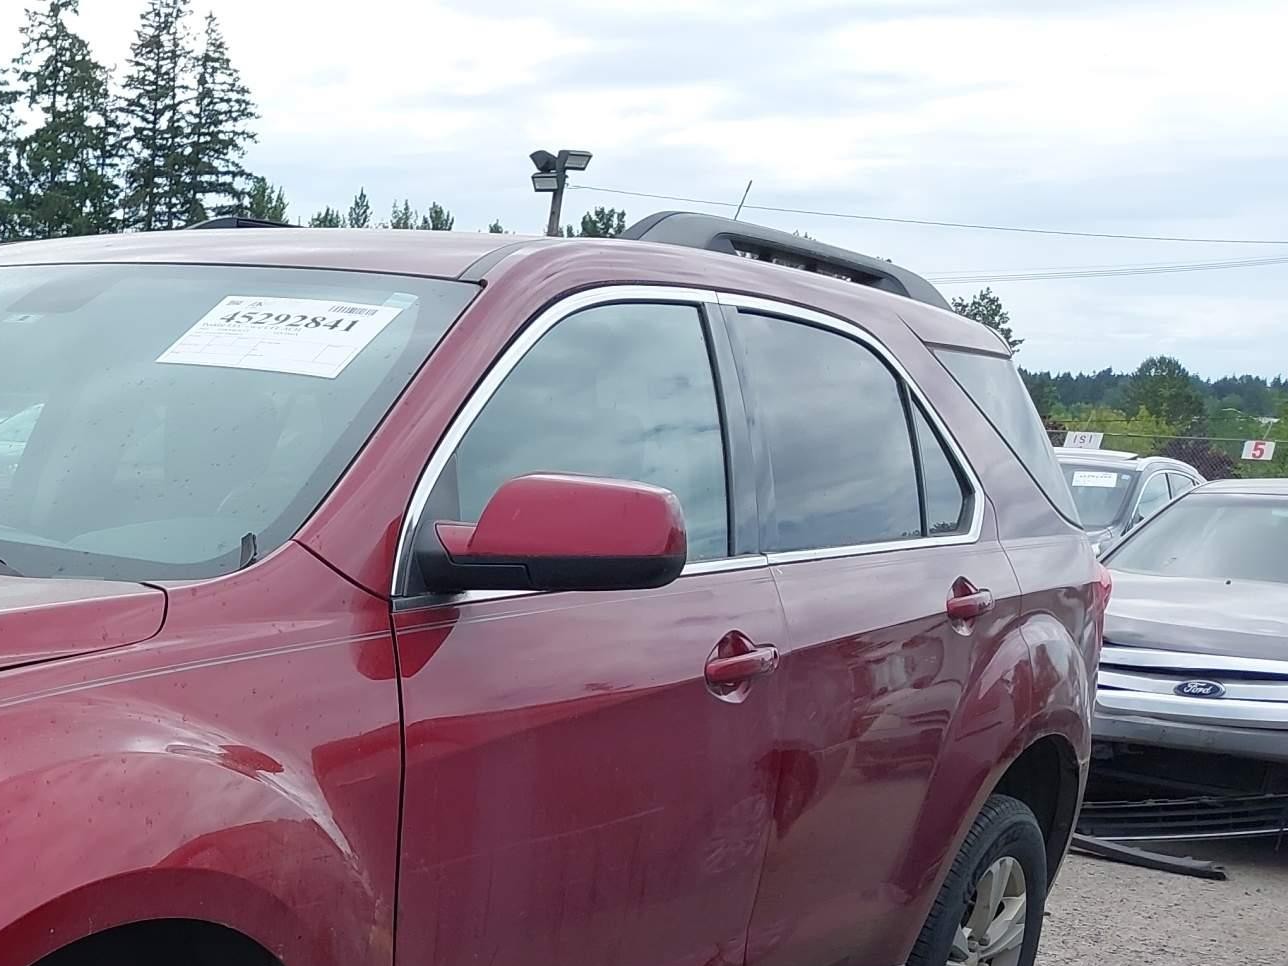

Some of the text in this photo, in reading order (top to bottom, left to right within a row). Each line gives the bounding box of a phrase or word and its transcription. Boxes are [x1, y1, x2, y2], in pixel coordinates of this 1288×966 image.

[218, 310, 360, 333] 45292841
[1251, 441, 1266, 459] 5
[1183, 682, 1214, 694] Ford
